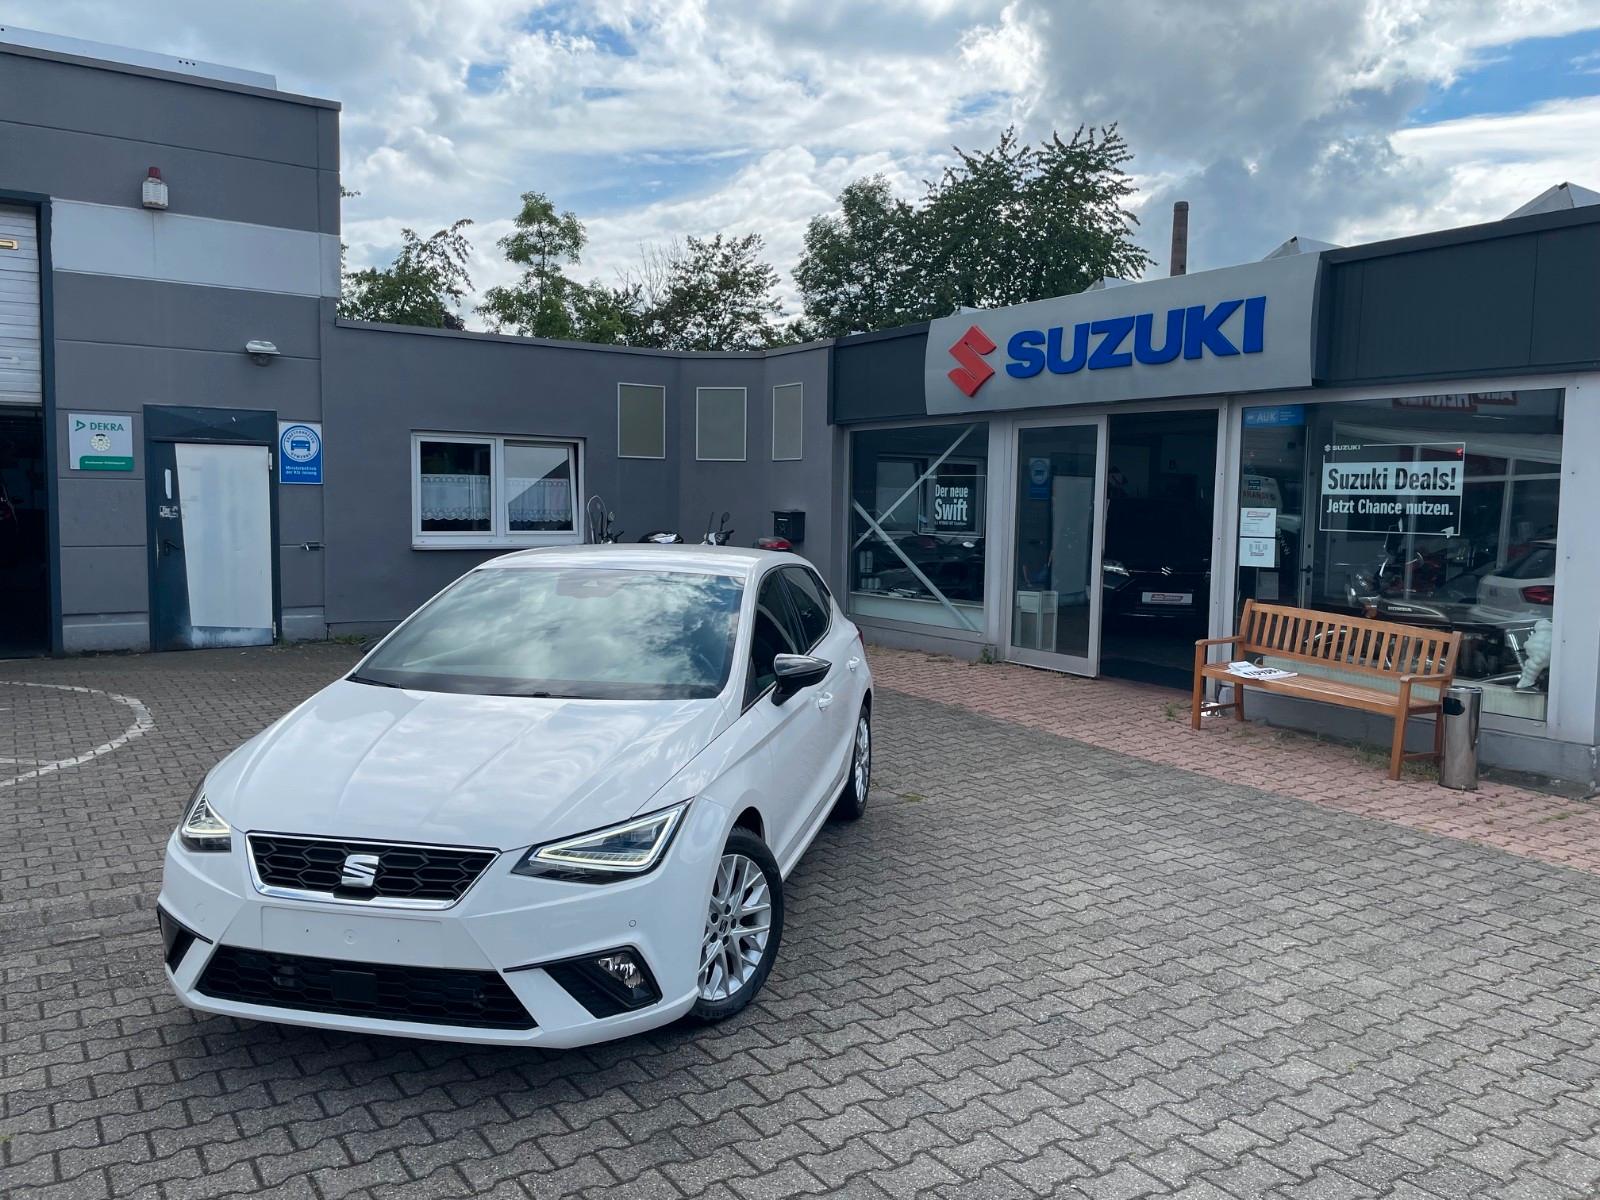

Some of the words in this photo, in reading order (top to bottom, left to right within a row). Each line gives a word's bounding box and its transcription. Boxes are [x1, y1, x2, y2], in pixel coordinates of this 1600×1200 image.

[1005, 296, 1267, 379] SUZUKI
[90, 422, 125, 432] DEKRA
[1327, 467, 1388, 490] Suzuki
[1394, 466, 1457, 491] Deals!
[935, 484, 949, 498] Der
[949, 486, 969, 498] neue
[934, 498, 968, 521] Swift
[1326, 498, 1355, 514] Jetzt
[1357, 498, 1403, 515] Chance
[1405, 500, 1454, 516] nutzen.
